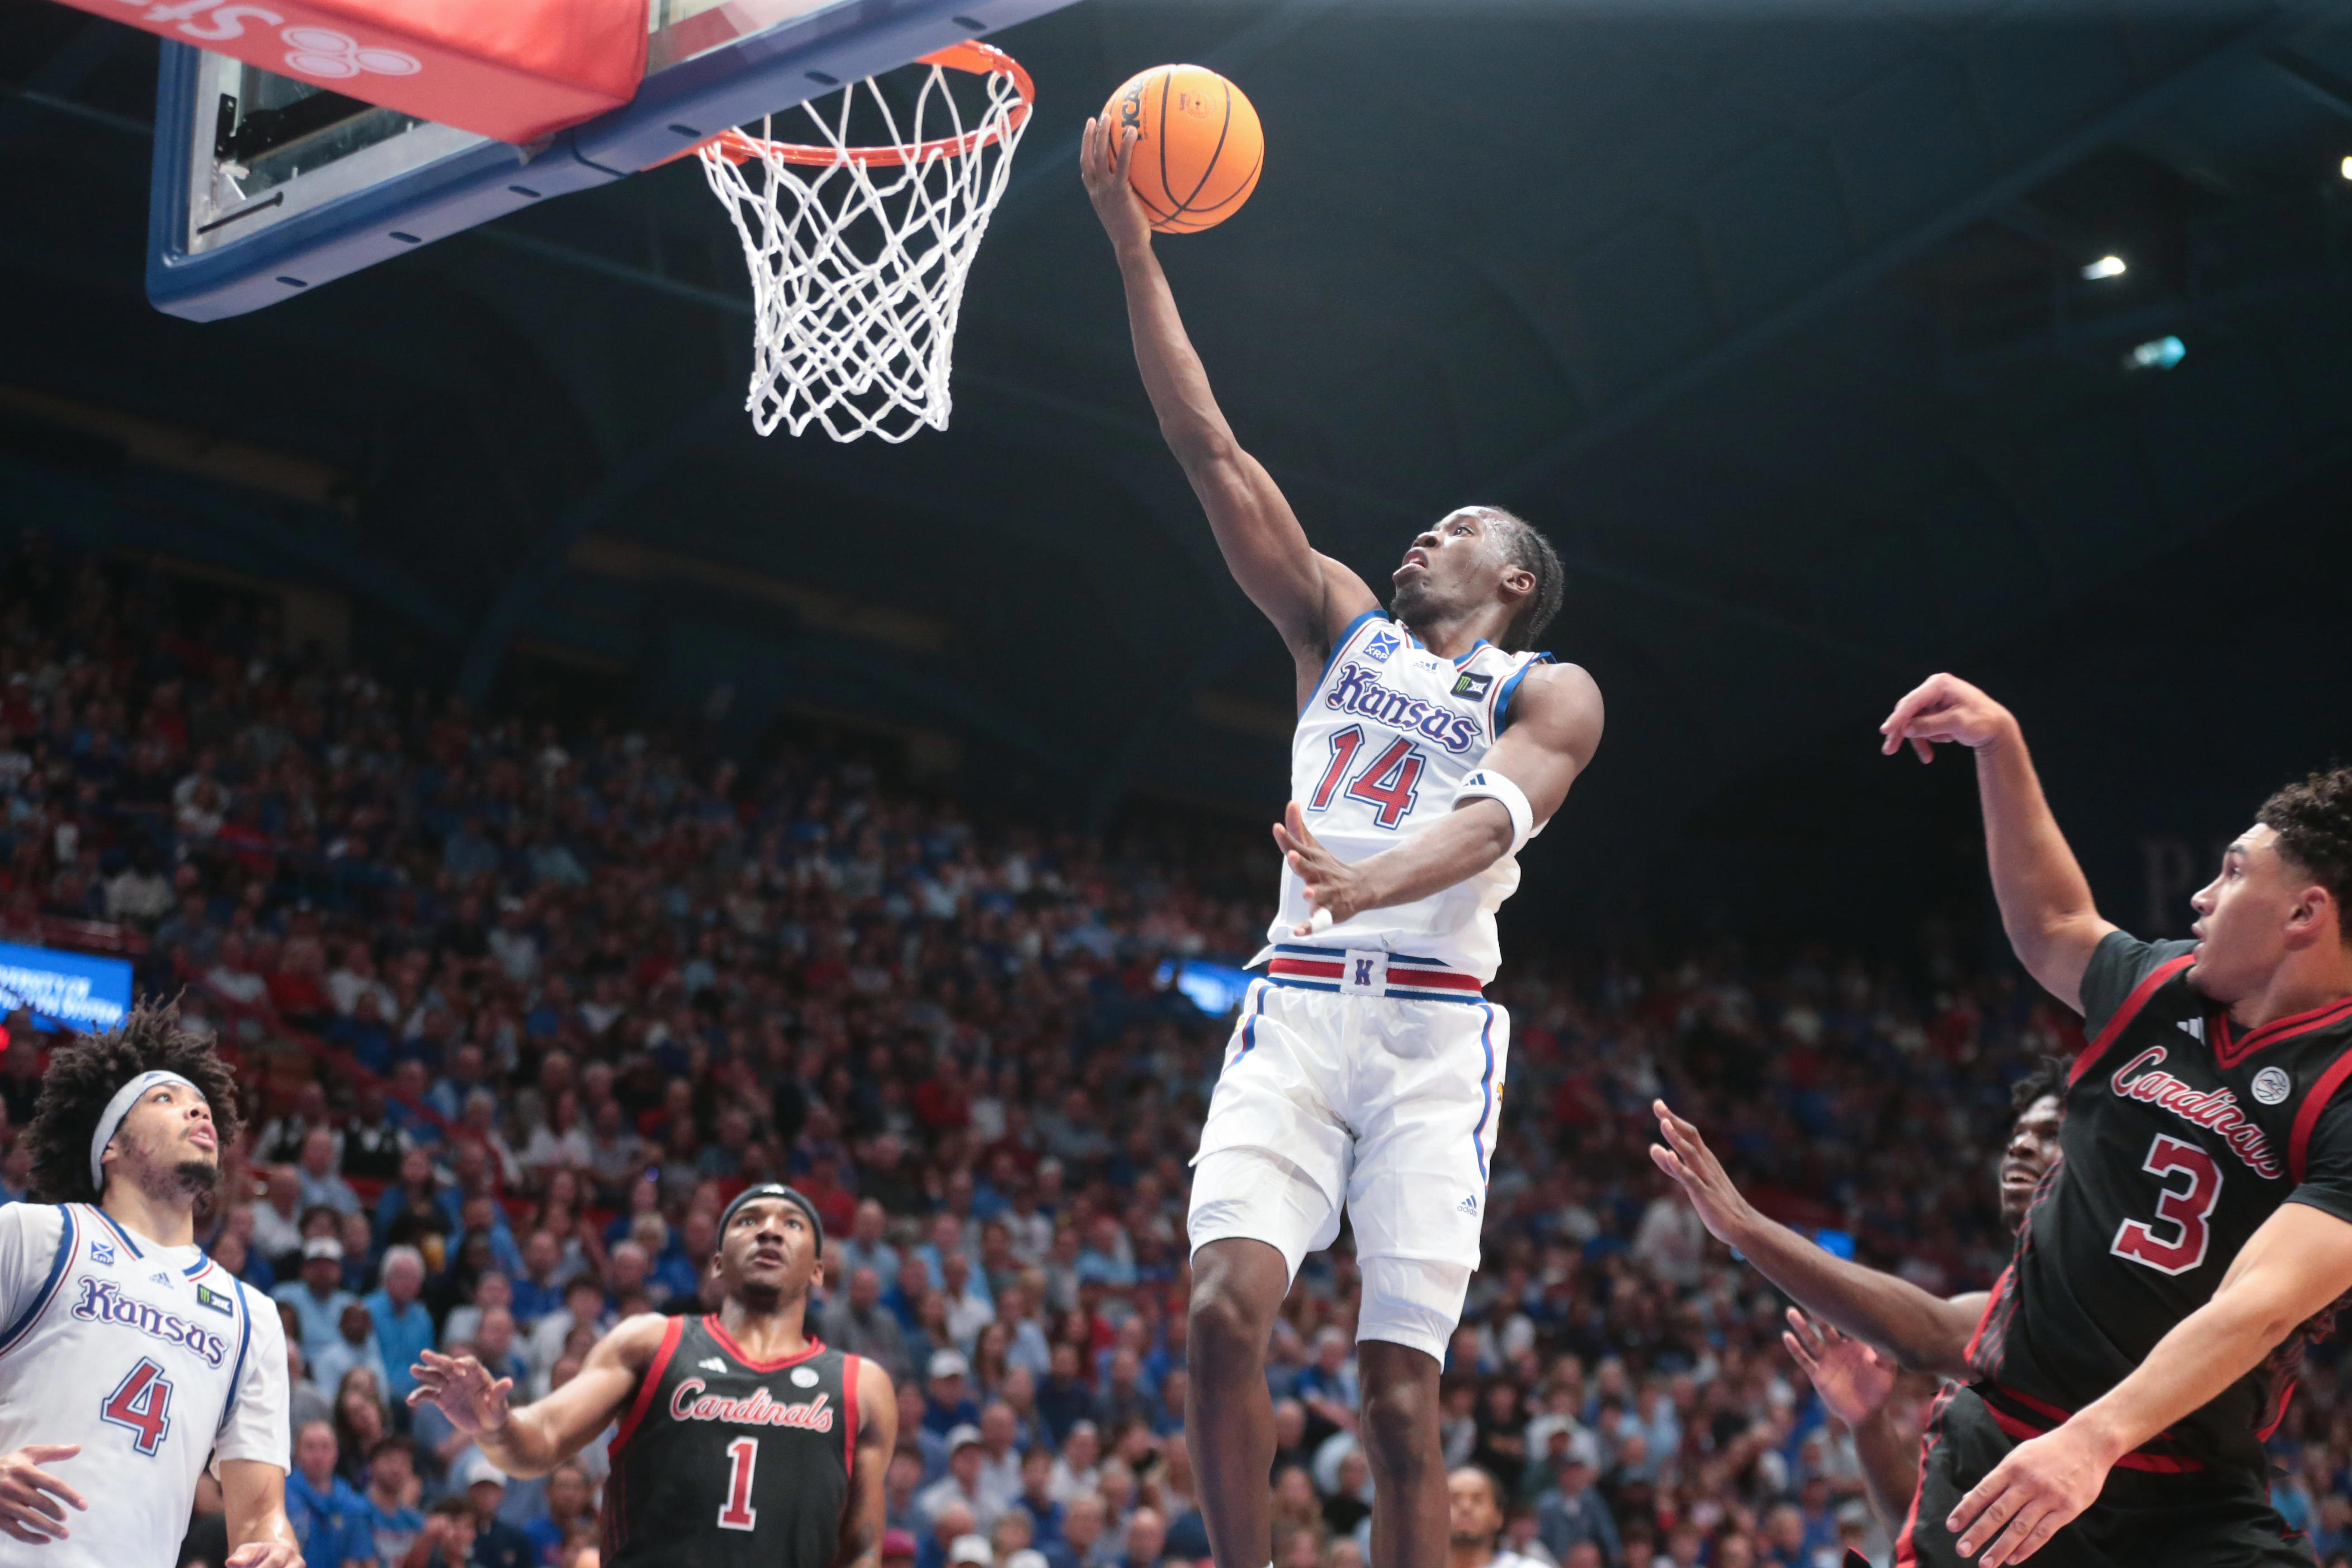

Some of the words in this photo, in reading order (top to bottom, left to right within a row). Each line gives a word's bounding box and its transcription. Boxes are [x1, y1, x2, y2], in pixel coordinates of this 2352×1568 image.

[1365, 645, 1388, 660] XRP
[1325, 662, 1482, 754] Kansas
[1308, 724, 1426, 830] 14
[1355, 959, 1375, 986] K
[2110, 1132, 2224, 1276] 3
[72, 1275, 228, 1369] Kansas
[101, 1356, 173, 1457] 4
[669, 1377, 834, 1433] Cardinals
[717, 1436, 758, 1531] 1
